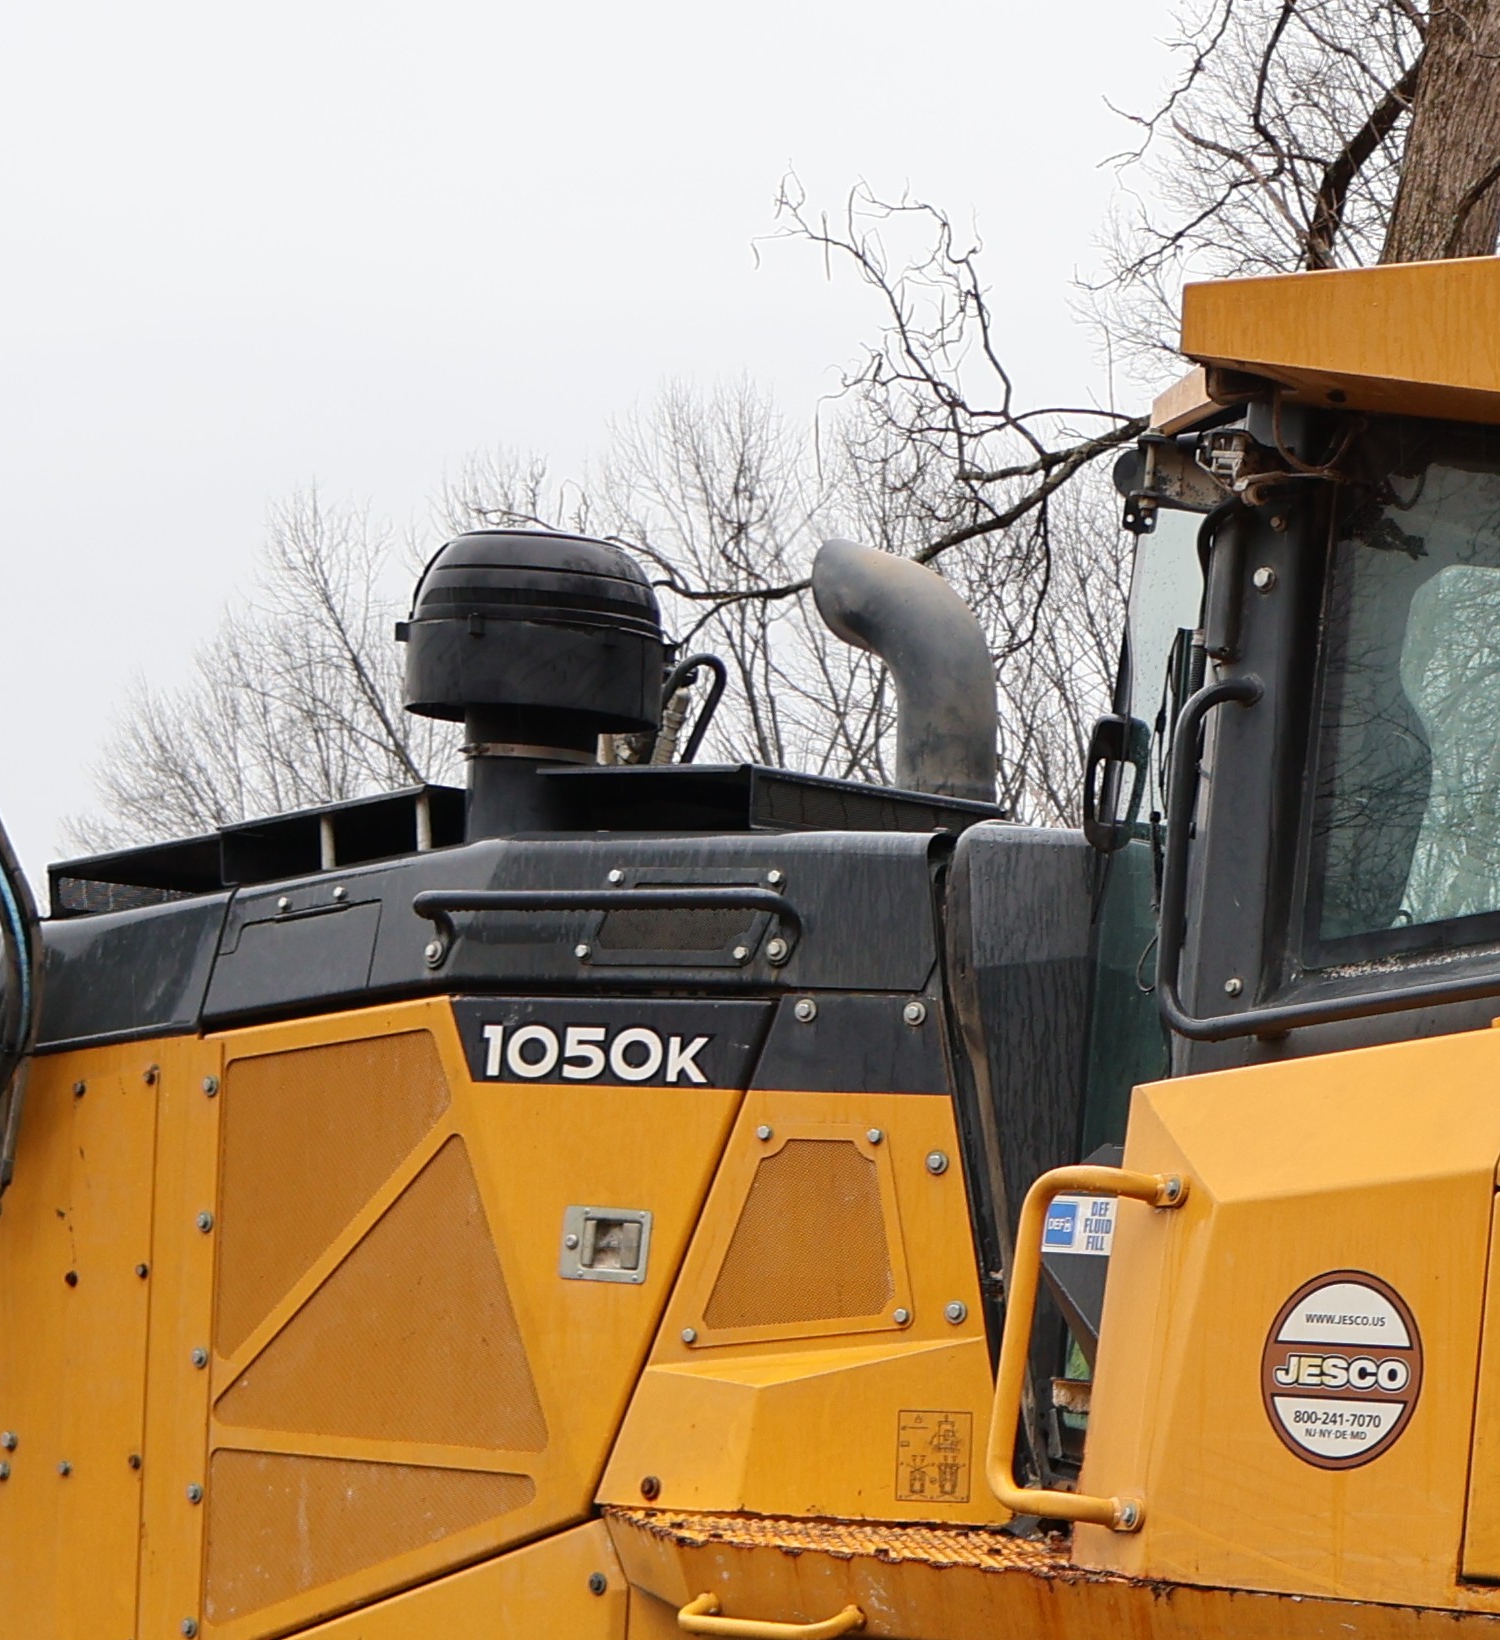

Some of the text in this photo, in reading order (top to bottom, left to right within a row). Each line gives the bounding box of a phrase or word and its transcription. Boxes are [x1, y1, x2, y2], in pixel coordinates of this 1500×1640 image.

[482, 1024, 710, 1084] 1050K
[1091, 1201, 1110, 1217] DEF
[1083, 1217, 1112, 1234] FLUID
[1085, 1235, 1104, 1251] FILL
[1305, 1313, 1386, 1327] WWW.JESCO.US
[1274, 1353, 1410, 1392] JESCO
[1293, 1410, 1382, 1428] 800-241-7070
